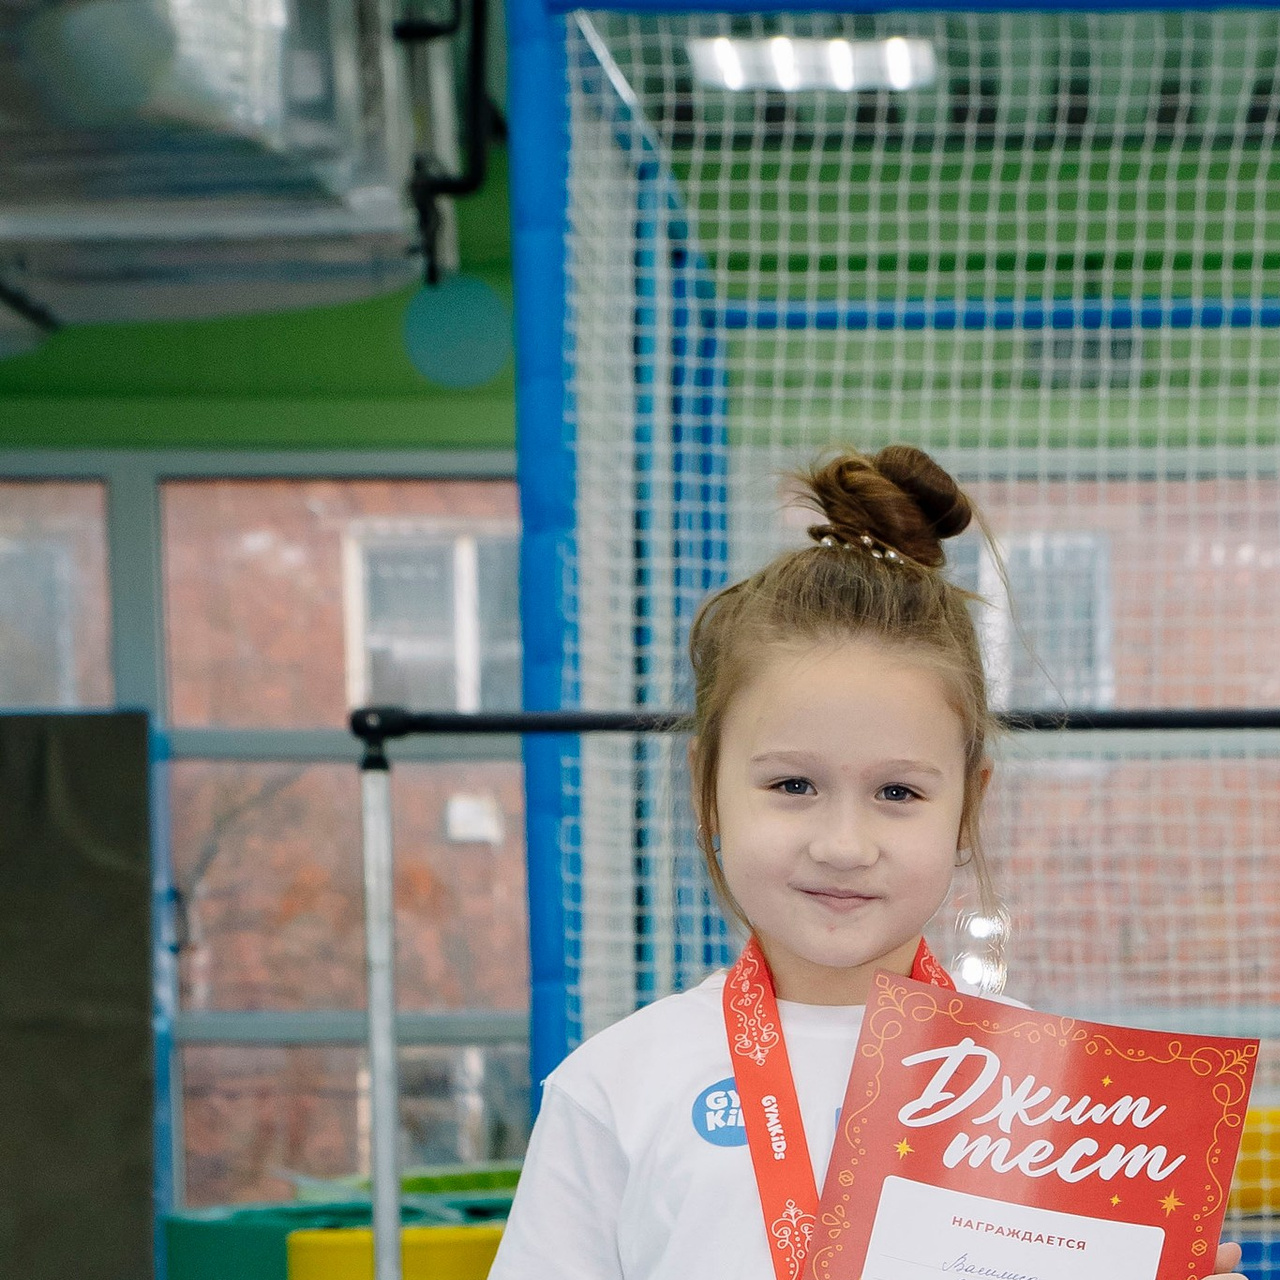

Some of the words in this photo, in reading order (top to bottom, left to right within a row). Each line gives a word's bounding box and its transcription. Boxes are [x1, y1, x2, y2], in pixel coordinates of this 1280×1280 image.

[705, 1090, 741, 1110] GY
[898, 1037, 1167, 1133] Джим
[943, 1132, 1186, 1183] тест
[951, 1215, 1087, 1251] НАГРАЖДАЕТСЯ
